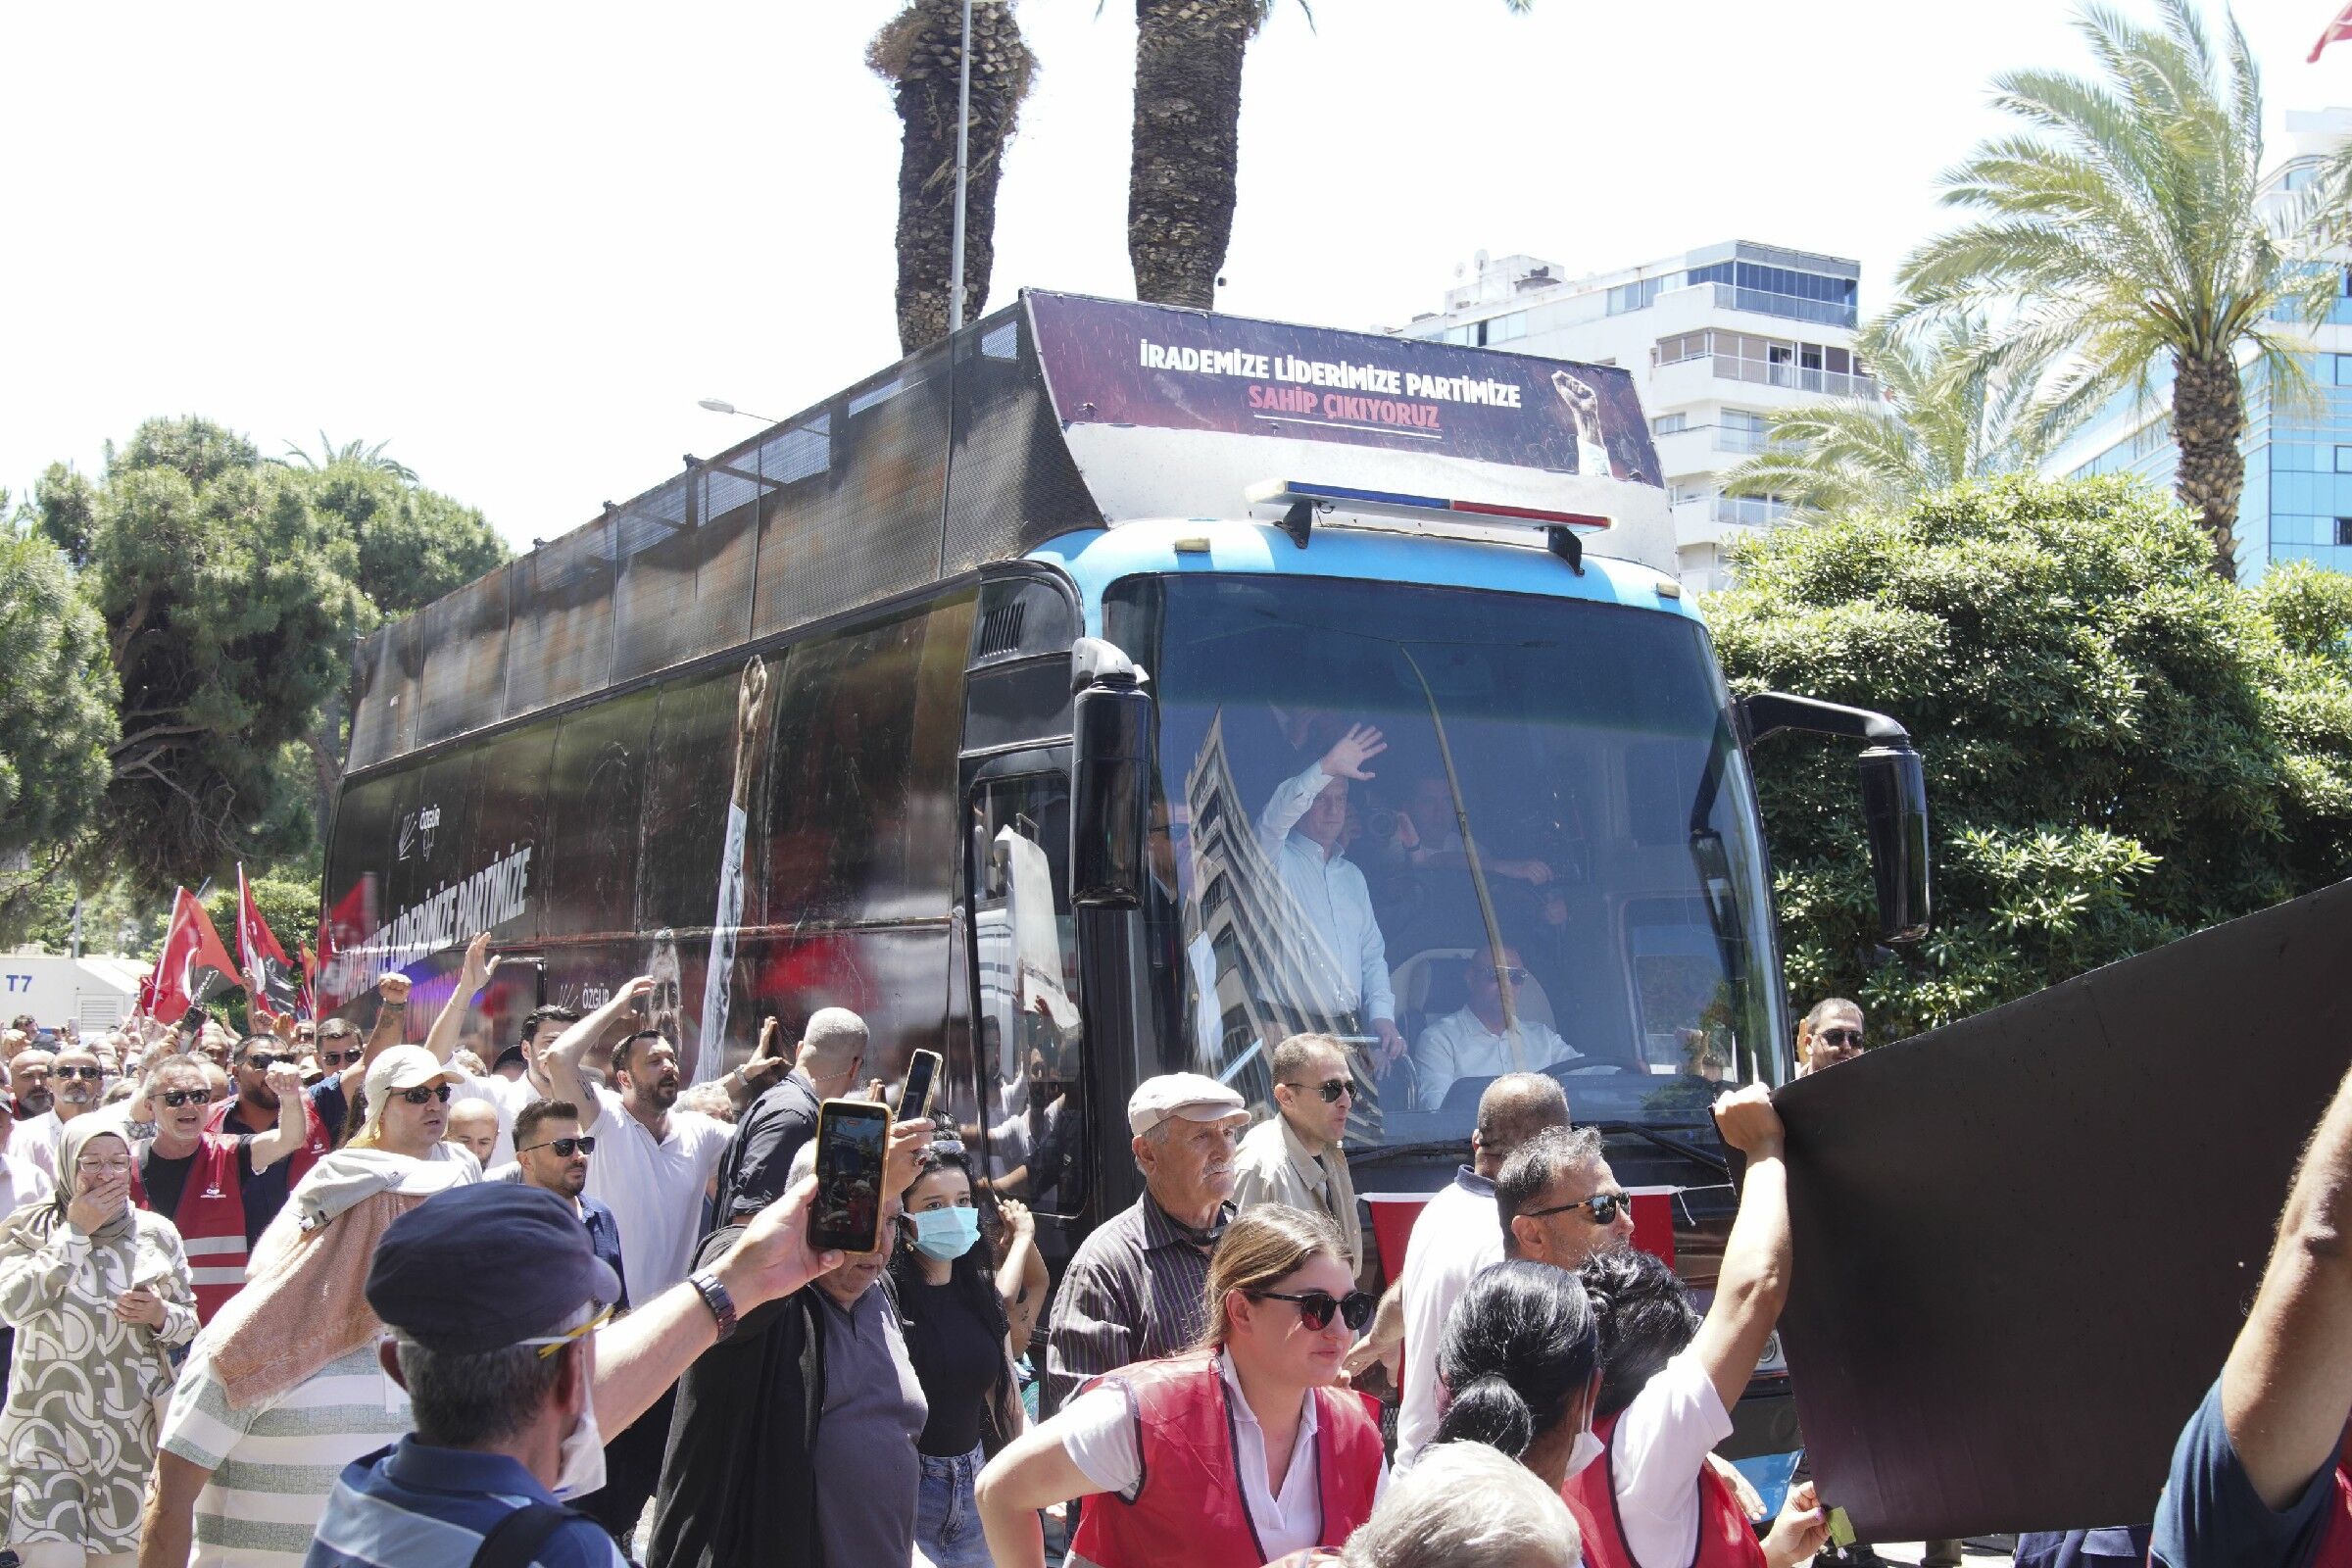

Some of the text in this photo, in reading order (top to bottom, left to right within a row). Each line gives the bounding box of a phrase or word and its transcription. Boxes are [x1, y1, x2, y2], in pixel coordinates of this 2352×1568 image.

[1140, 338, 1522, 409] İRADEMİZE LİDERİMİZE PARTİMİZE
[1248, 384, 1441, 429] SAHİP ÇIKIYORUZ
[419, 804, 440, 830] ÖZGÜR
[455, 843, 532, 944] PARTİMİZE
[6, 974, 32, 992] T7
[582, 982, 610, 1009] ÖZGÜR
